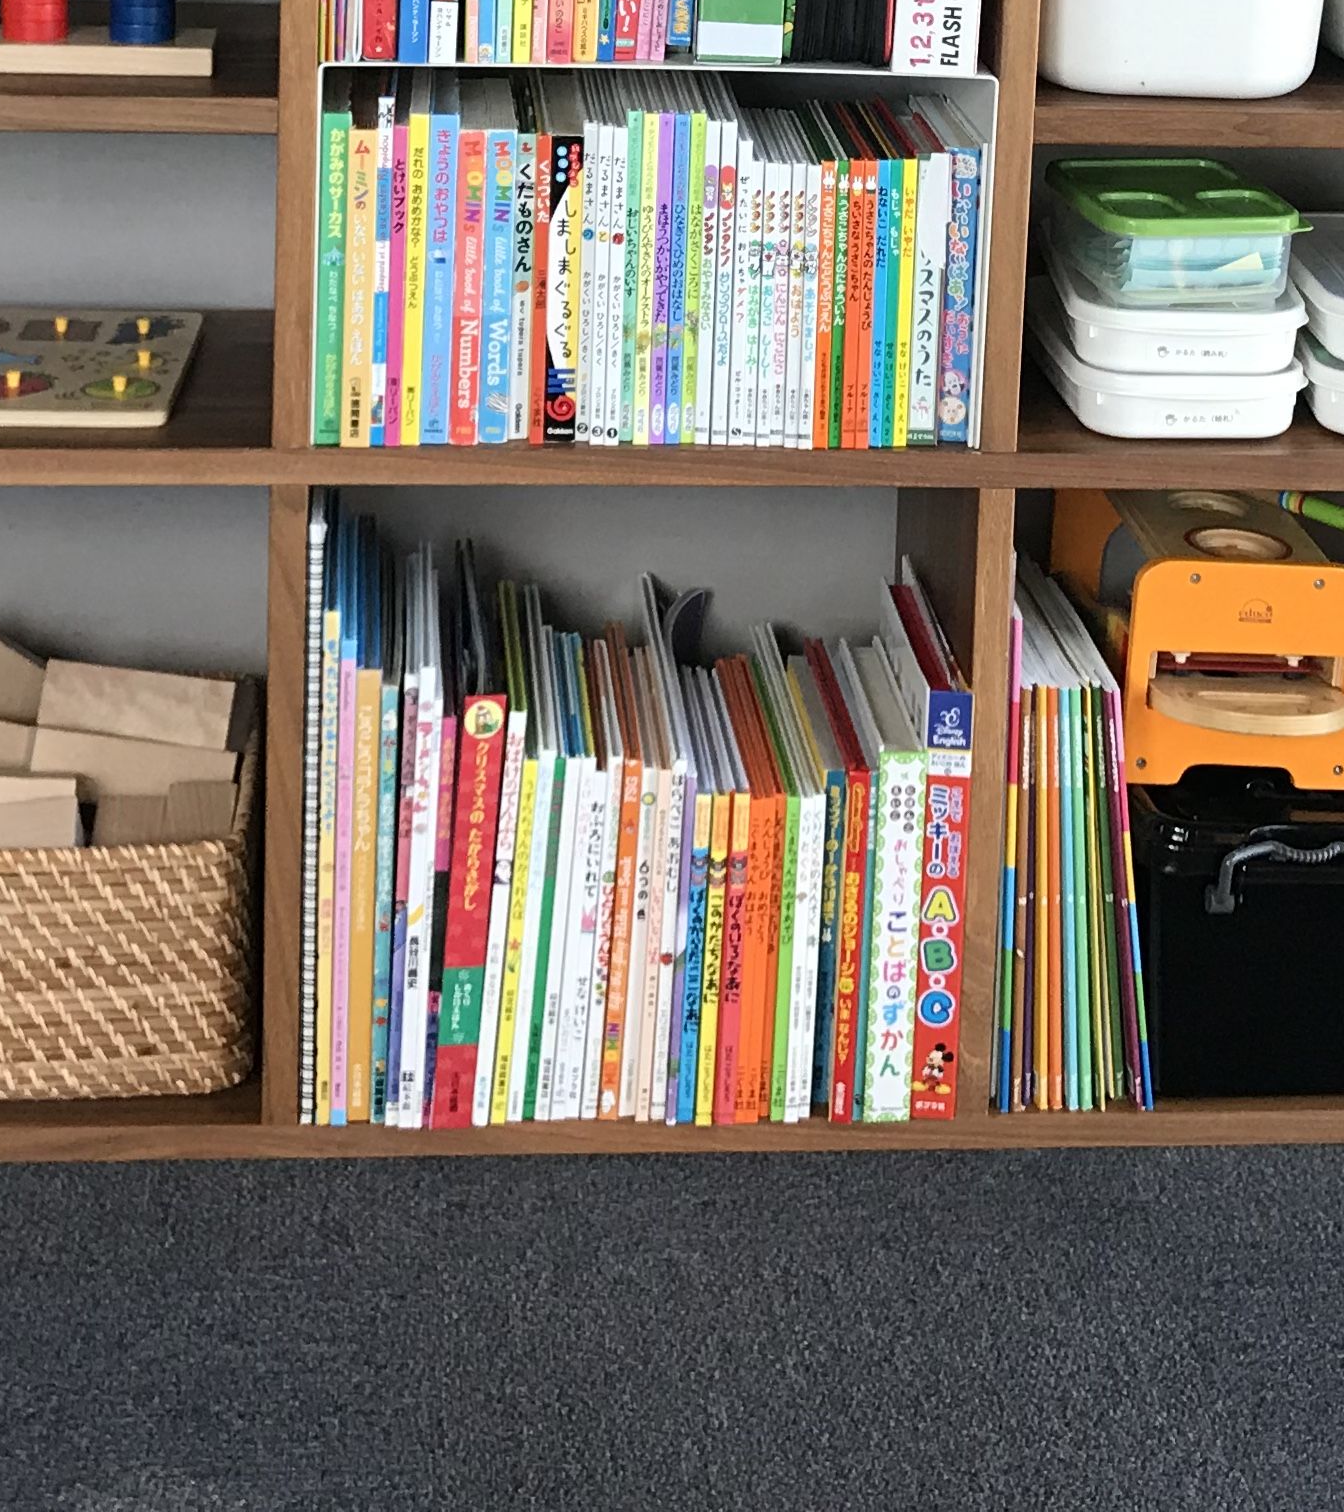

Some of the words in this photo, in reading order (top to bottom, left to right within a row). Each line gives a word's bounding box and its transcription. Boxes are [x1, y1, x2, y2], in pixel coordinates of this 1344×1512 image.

[939, 5, 963, 67] FLASH
[327, 127, 346, 239] かがみのサーカス
[393, 158, 406, 234] とけいブック
[412, 147, 424, 179] だれの
[433, 129, 452, 243] きょうのおやつは
[536, 160, 551, 224] くっついた
[582, 152, 596, 241] だるまさんの
[597, 155, 611, 243] だるまさんと
[410, 184, 423, 248] おめめかな?
[516, 163, 534, 273] くだものさん
[612, 156, 626, 245] だるまさんが
[703, 212, 715, 256] ノンタン
[738, 176, 751, 234] ぜったいに
[850, 201, 862, 240] ちいさな
[877, 187, 888, 230] ねないこ
[891, 189, 901, 218] もじゃ
[904, 187, 915, 219] いやだ
[890, 227, 900, 256] もじゃ
[902, 225, 913, 258] いやだ
[554, 199, 577, 359] しましまぐるぐる
[790, 284, 803, 339] おはよう
[457, 319, 479, 410] Numbers
[487, 318, 509, 387] Words
[932, 735, 967, 747] English
[468, 741, 491, 824] クリスマスの
[497, 732, 523, 851] おばけのてんぷら
[671, 775, 683, 830] はらぺこ
[584, 801, 606, 899] おふろにいれて
[666, 837, 681, 893] あおむし
[927, 785, 949, 877] ミッキーの
[462, 827, 484, 912] たからさがし
[724, 893, 745, 1004] ぼくのいろなあに
[841, 871, 860, 976] おさるのジョージ
[879, 911, 908, 1078] ことばのずかん
